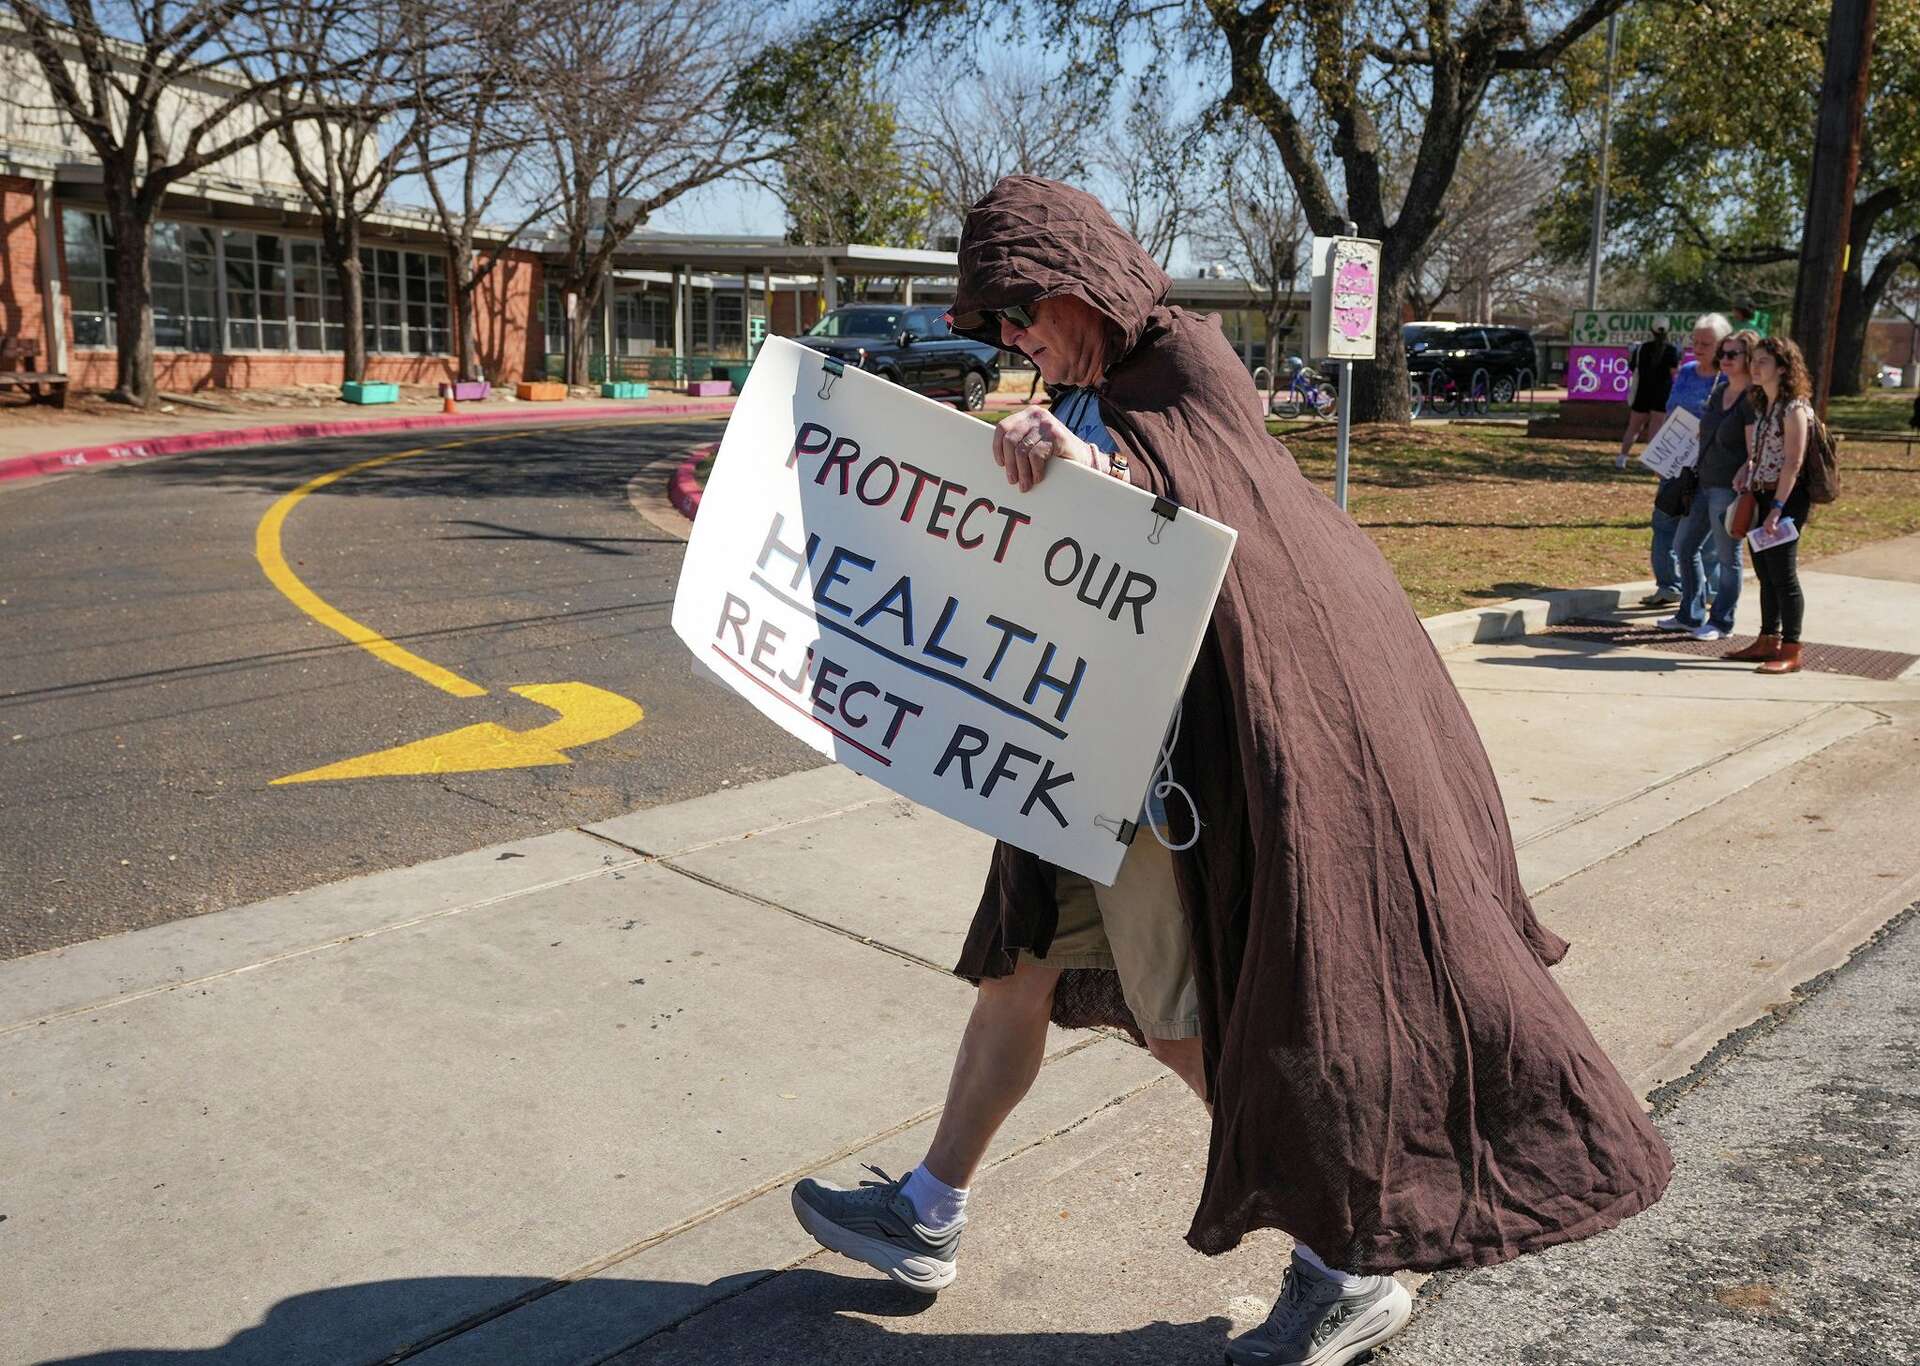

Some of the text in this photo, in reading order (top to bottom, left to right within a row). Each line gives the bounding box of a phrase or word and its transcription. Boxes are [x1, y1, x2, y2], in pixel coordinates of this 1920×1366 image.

[1608, 315, 1697, 331] CUNNG
[1646, 415, 1691, 465] UNFIT
[785, 422, 1158, 635] PROTECT OUR
[755, 511, 1088, 723] HEALTH
[714, 592, 1076, 829] REJECT RFK
[1310, 1305, 1353, 1347] HOKA
